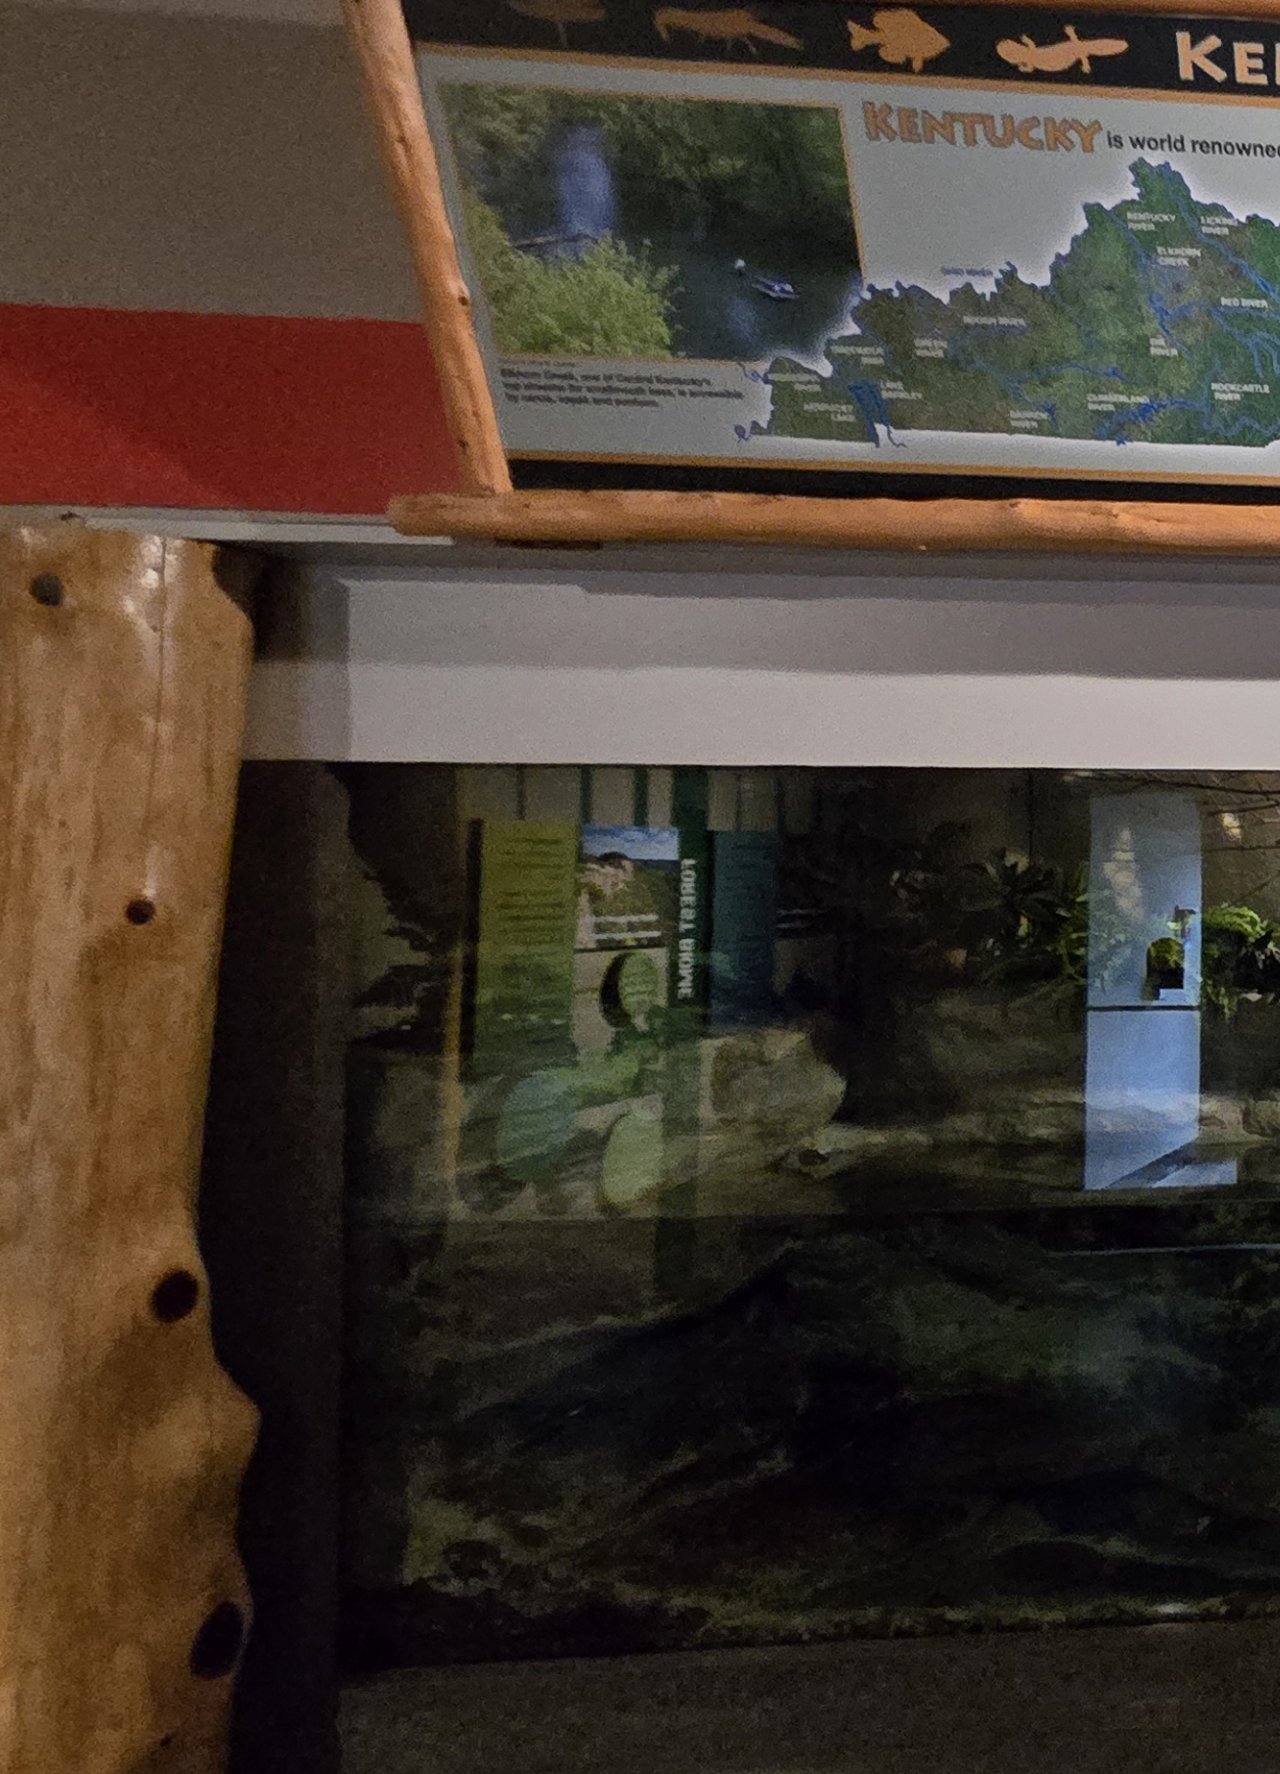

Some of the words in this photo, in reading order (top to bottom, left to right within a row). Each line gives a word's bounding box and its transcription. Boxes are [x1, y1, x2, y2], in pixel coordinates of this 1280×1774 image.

[861, 99, 1104, 154] KENTUCKY
[1107, 130, 1124, 150] is
[1129, 132, 1186, 153] world
